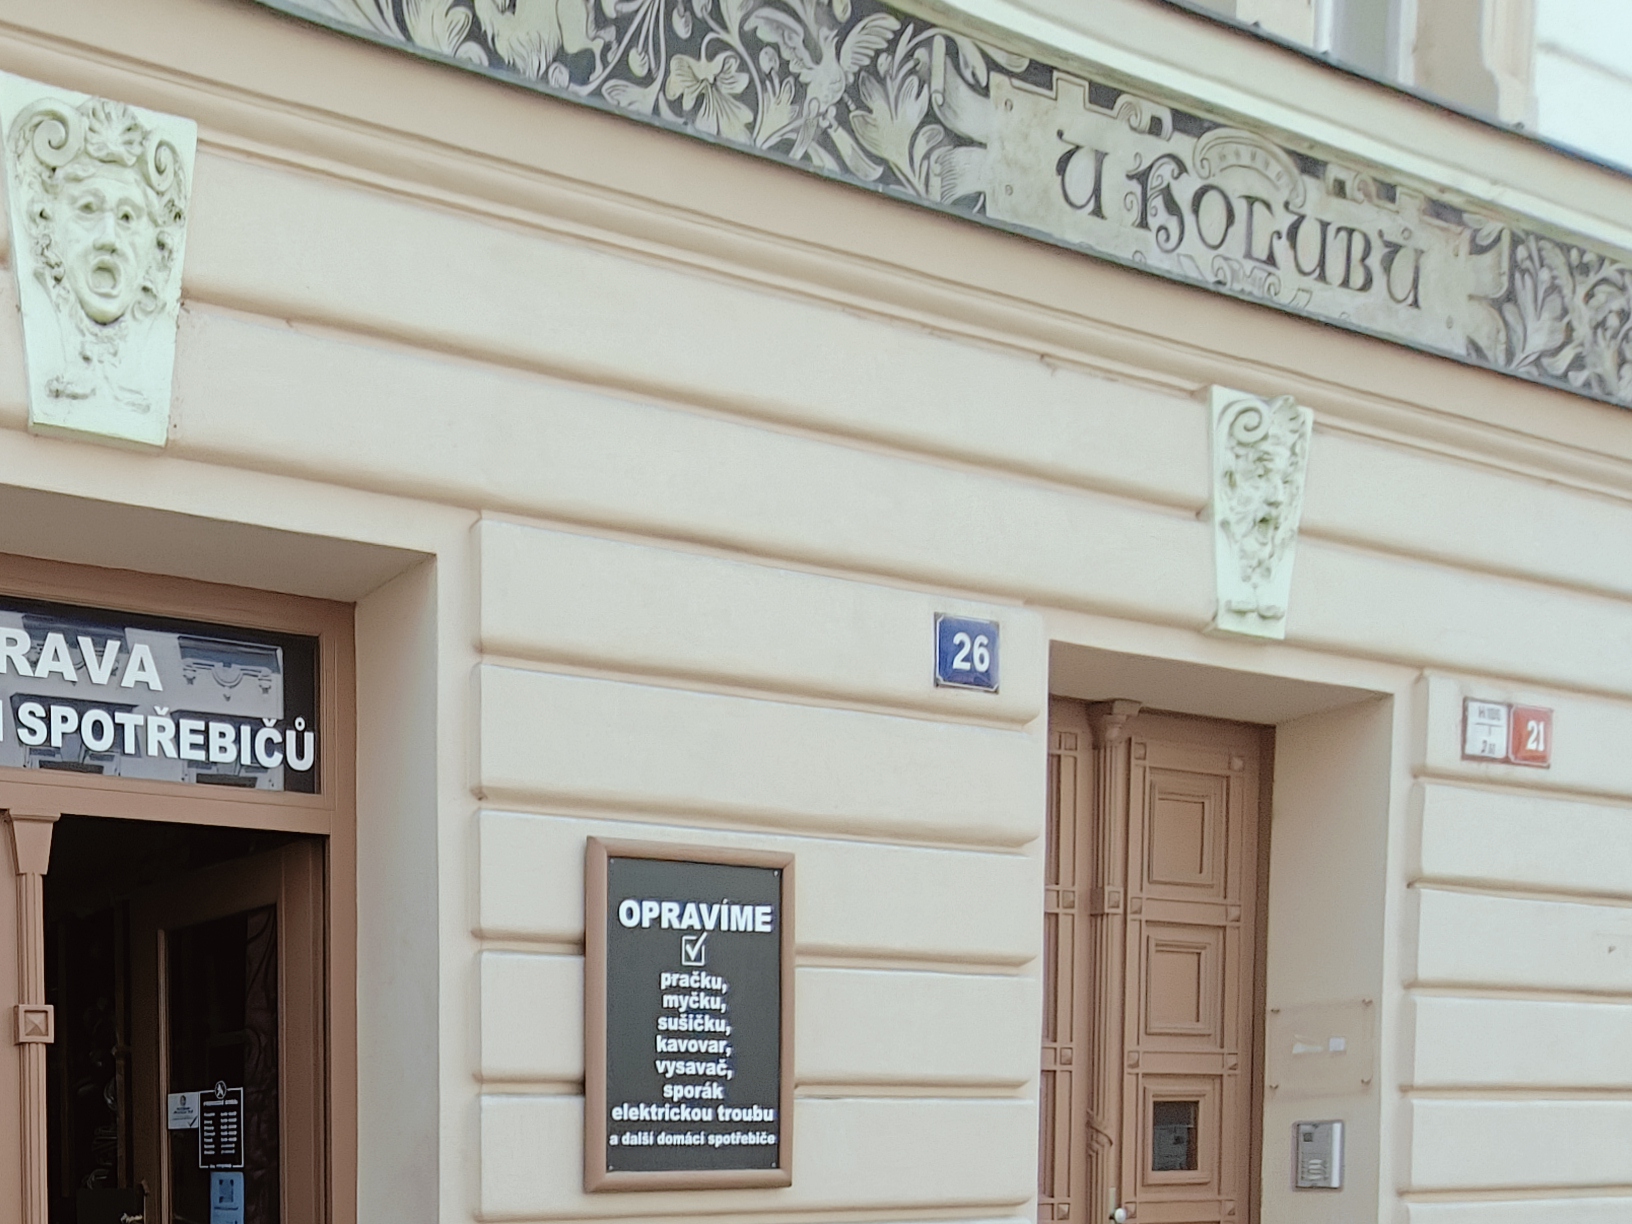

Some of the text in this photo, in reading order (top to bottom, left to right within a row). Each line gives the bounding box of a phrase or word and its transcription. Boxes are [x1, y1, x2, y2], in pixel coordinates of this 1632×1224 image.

[952, 631, 990, 673] 26
[16, 700, 316, 772] SPOTŘEBIČŮ
[1525, 720, 1546, 752] 21
[618, 898, 774, 933] OPRAVÍME
[660, 971, 728, 993] pračku,
[662, 991, 727, 1013] myčku,
[657, 1014, 732, 1036] sušičku,
[655, 1035, 732, 1057] kavovar,
[655, 1057, 733, 1080] vysavač,
[662, 1081, 724, 1102] sporák
[611, 1102, 775, 1123] elektrickou troubu
[609, 1130, 776, 1149] a další domácí spotřebiče
